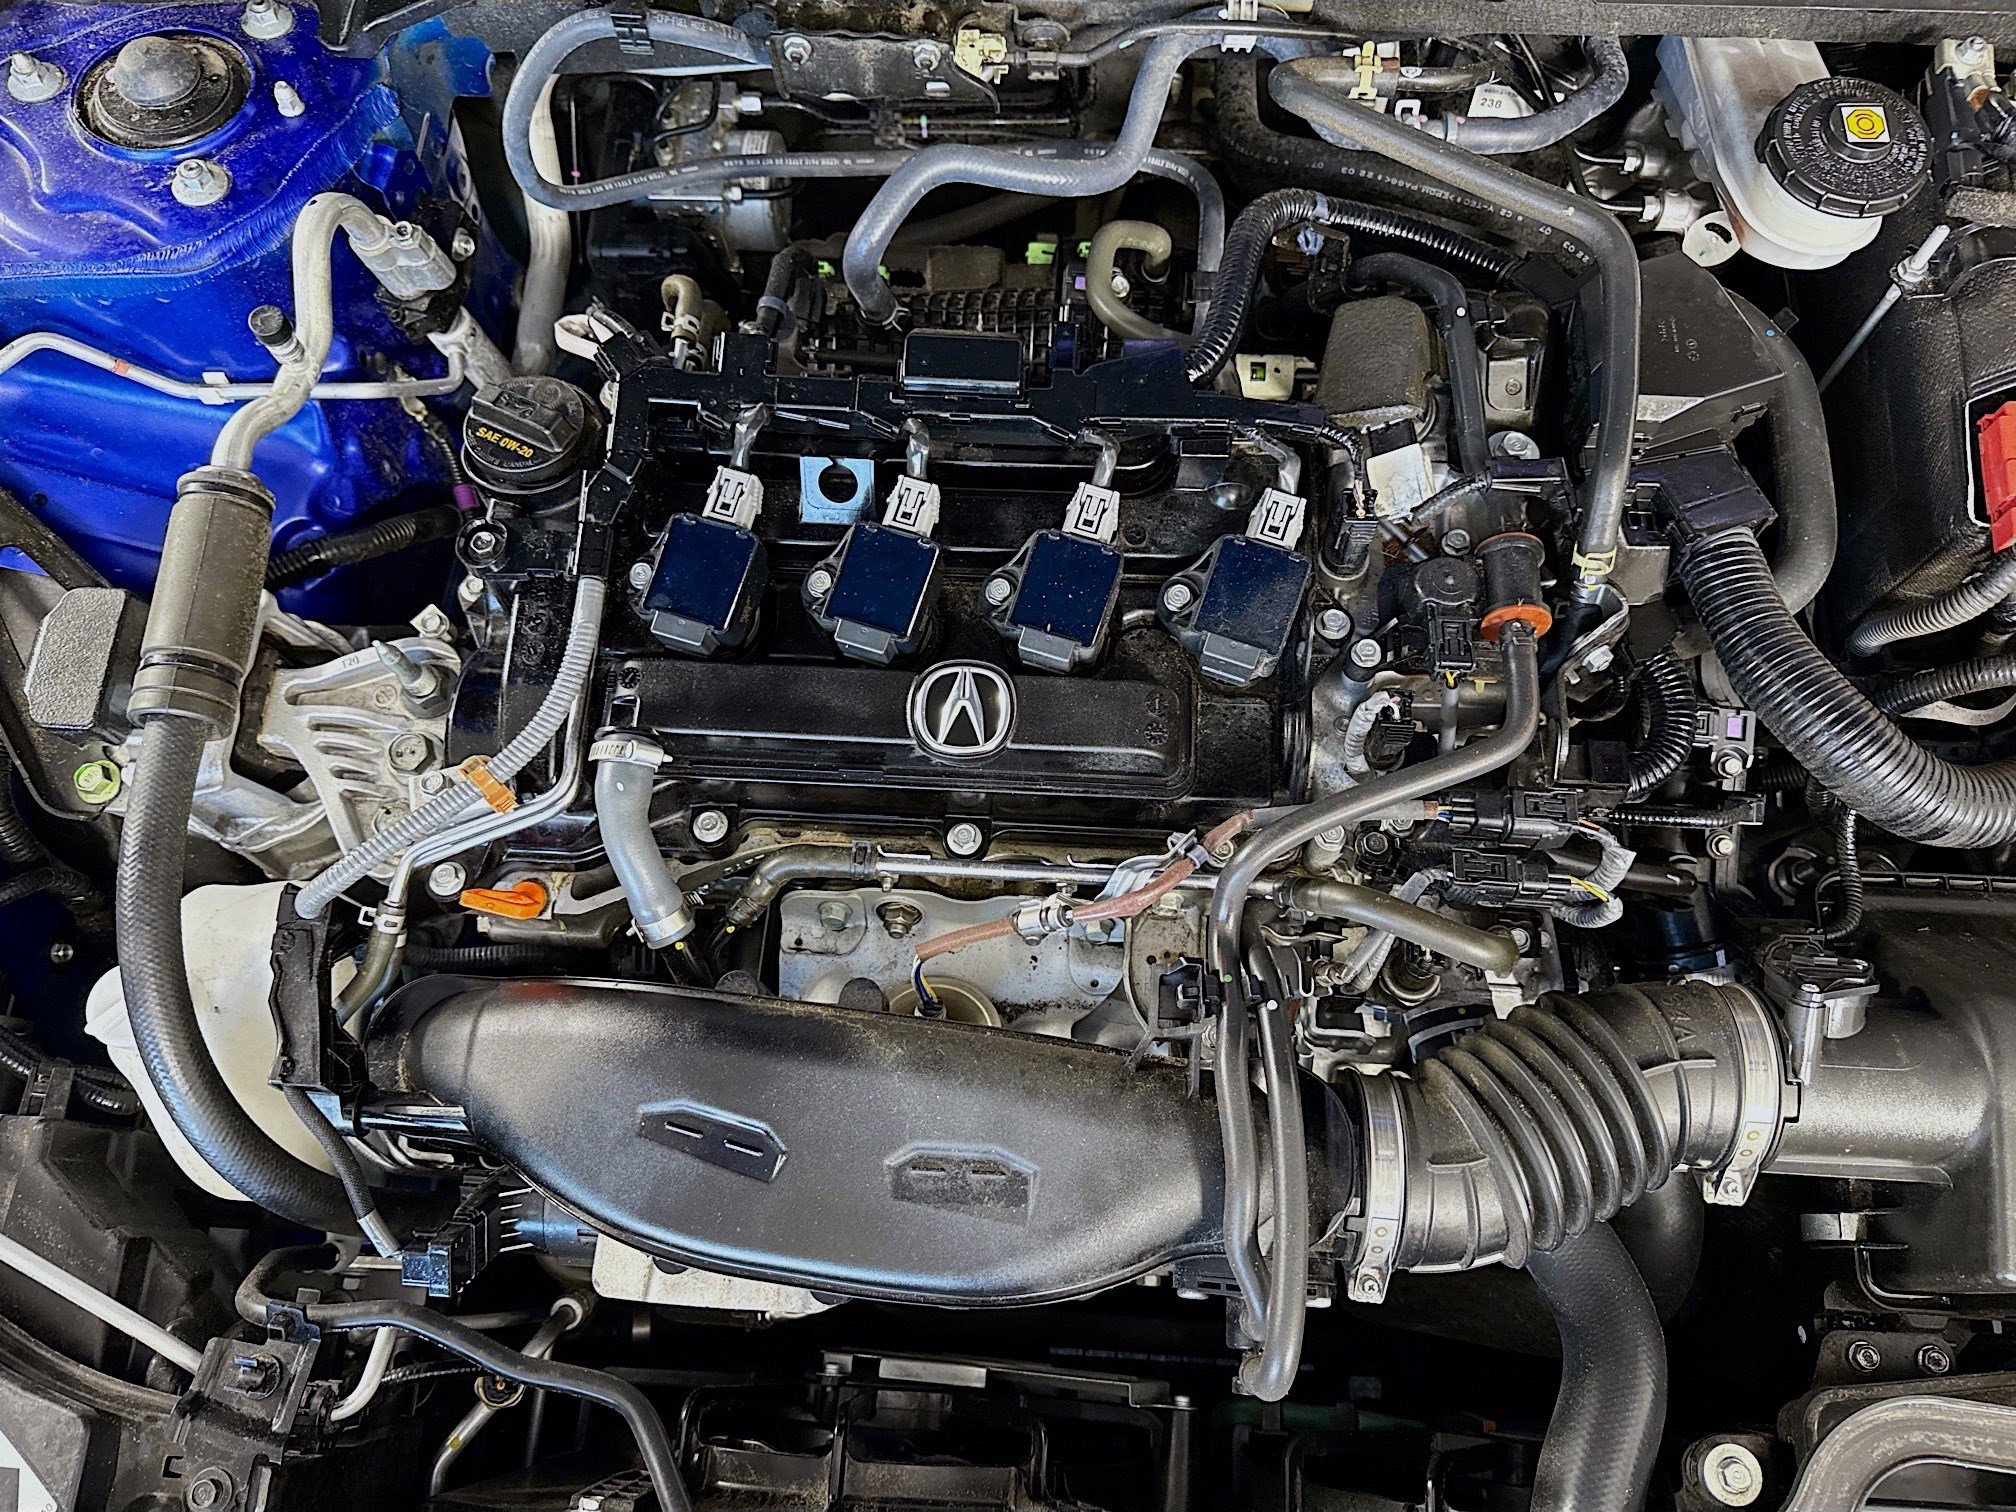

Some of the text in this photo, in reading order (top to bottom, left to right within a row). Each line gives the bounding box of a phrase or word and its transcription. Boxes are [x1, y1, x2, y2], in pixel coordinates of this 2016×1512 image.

[1480, 97, 1502, 109] 238
[476, 427, 502, 443] SAE
[500, 437, 534, 458] 0W-20
